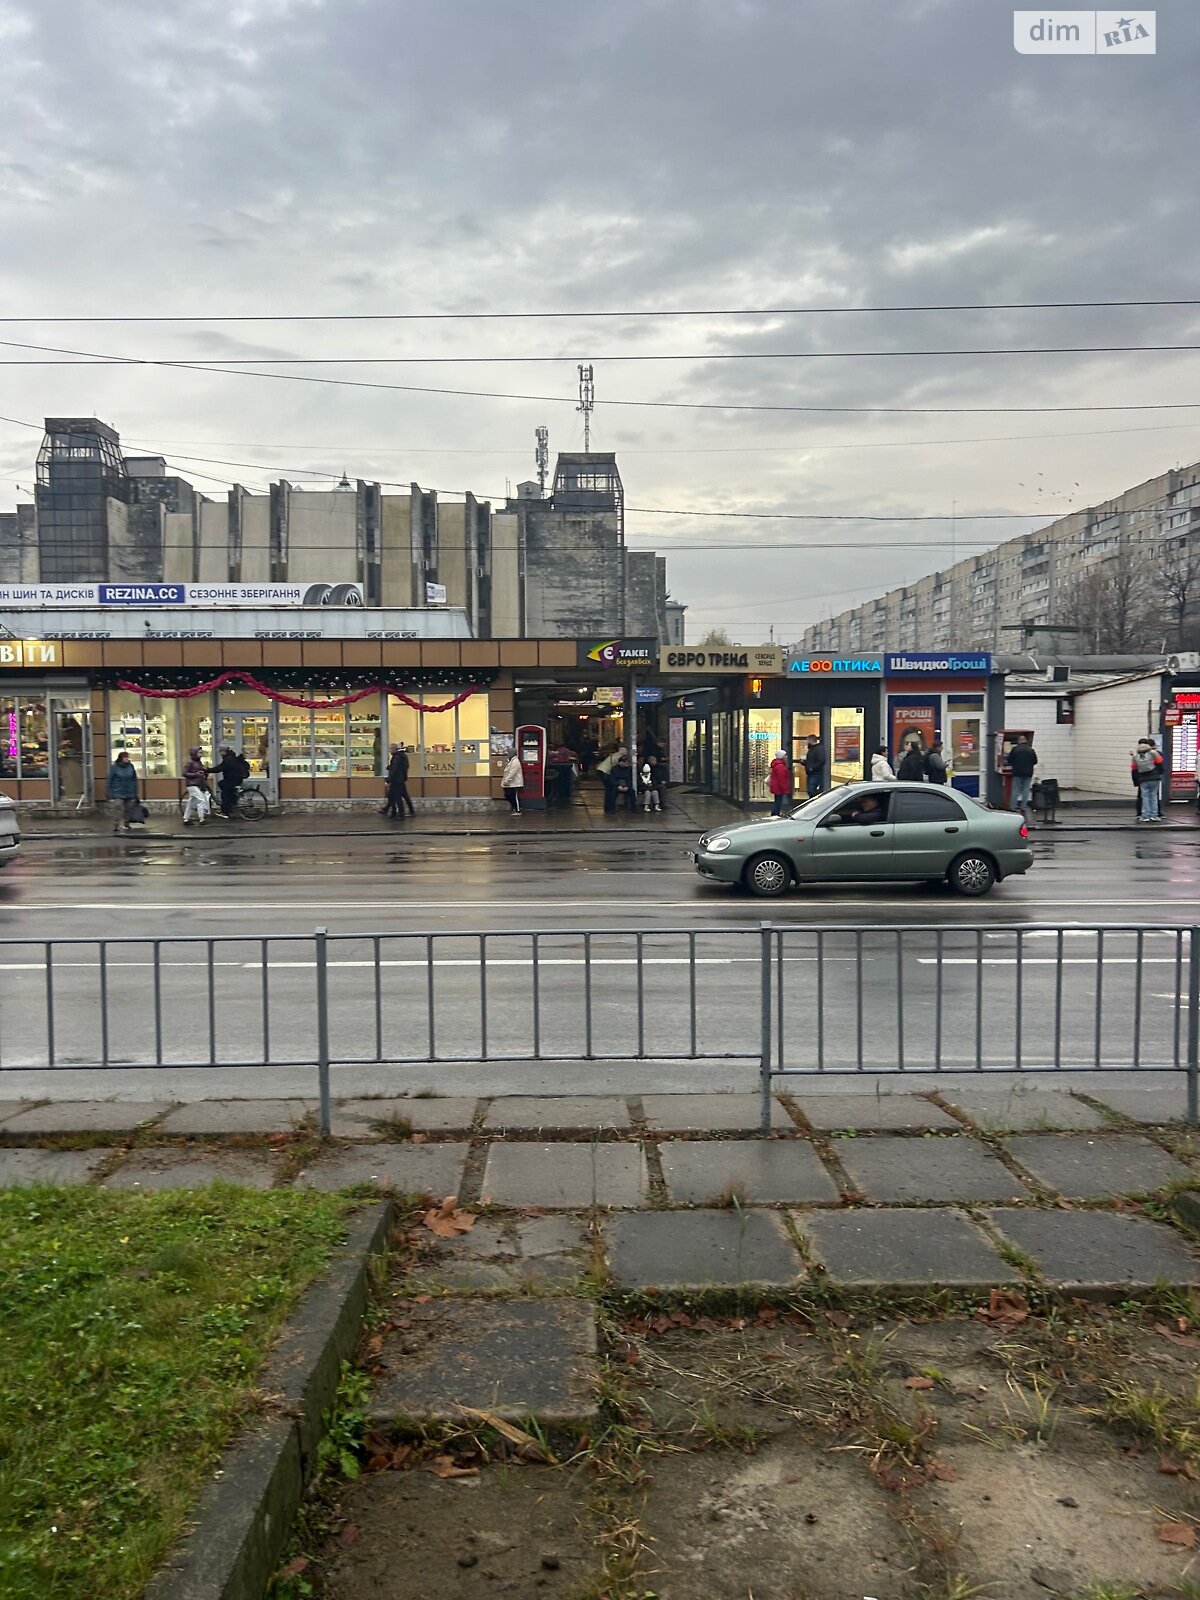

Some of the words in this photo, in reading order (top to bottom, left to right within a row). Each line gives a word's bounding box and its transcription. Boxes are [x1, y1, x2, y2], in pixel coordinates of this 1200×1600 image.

[13, 590, 37, 599] ШИН
[40, 590, 52, 599] ТА
[56, 589, 94, 600] ДИСКІВ
[106, 588, 178, 600] REZINA.CC
[189, 589, 238, 599] СЕЗОННЕ
[240, 588, 300, 599] ЗБЕРІГАННЯ
[667, 652, 706, 666] ЄВРО
[708, 652, 749, 667] ТРЕНД
[890, 657, 987, 671] ШвидкоГроші
[895, 709, 932, 718] ГРОШІ
